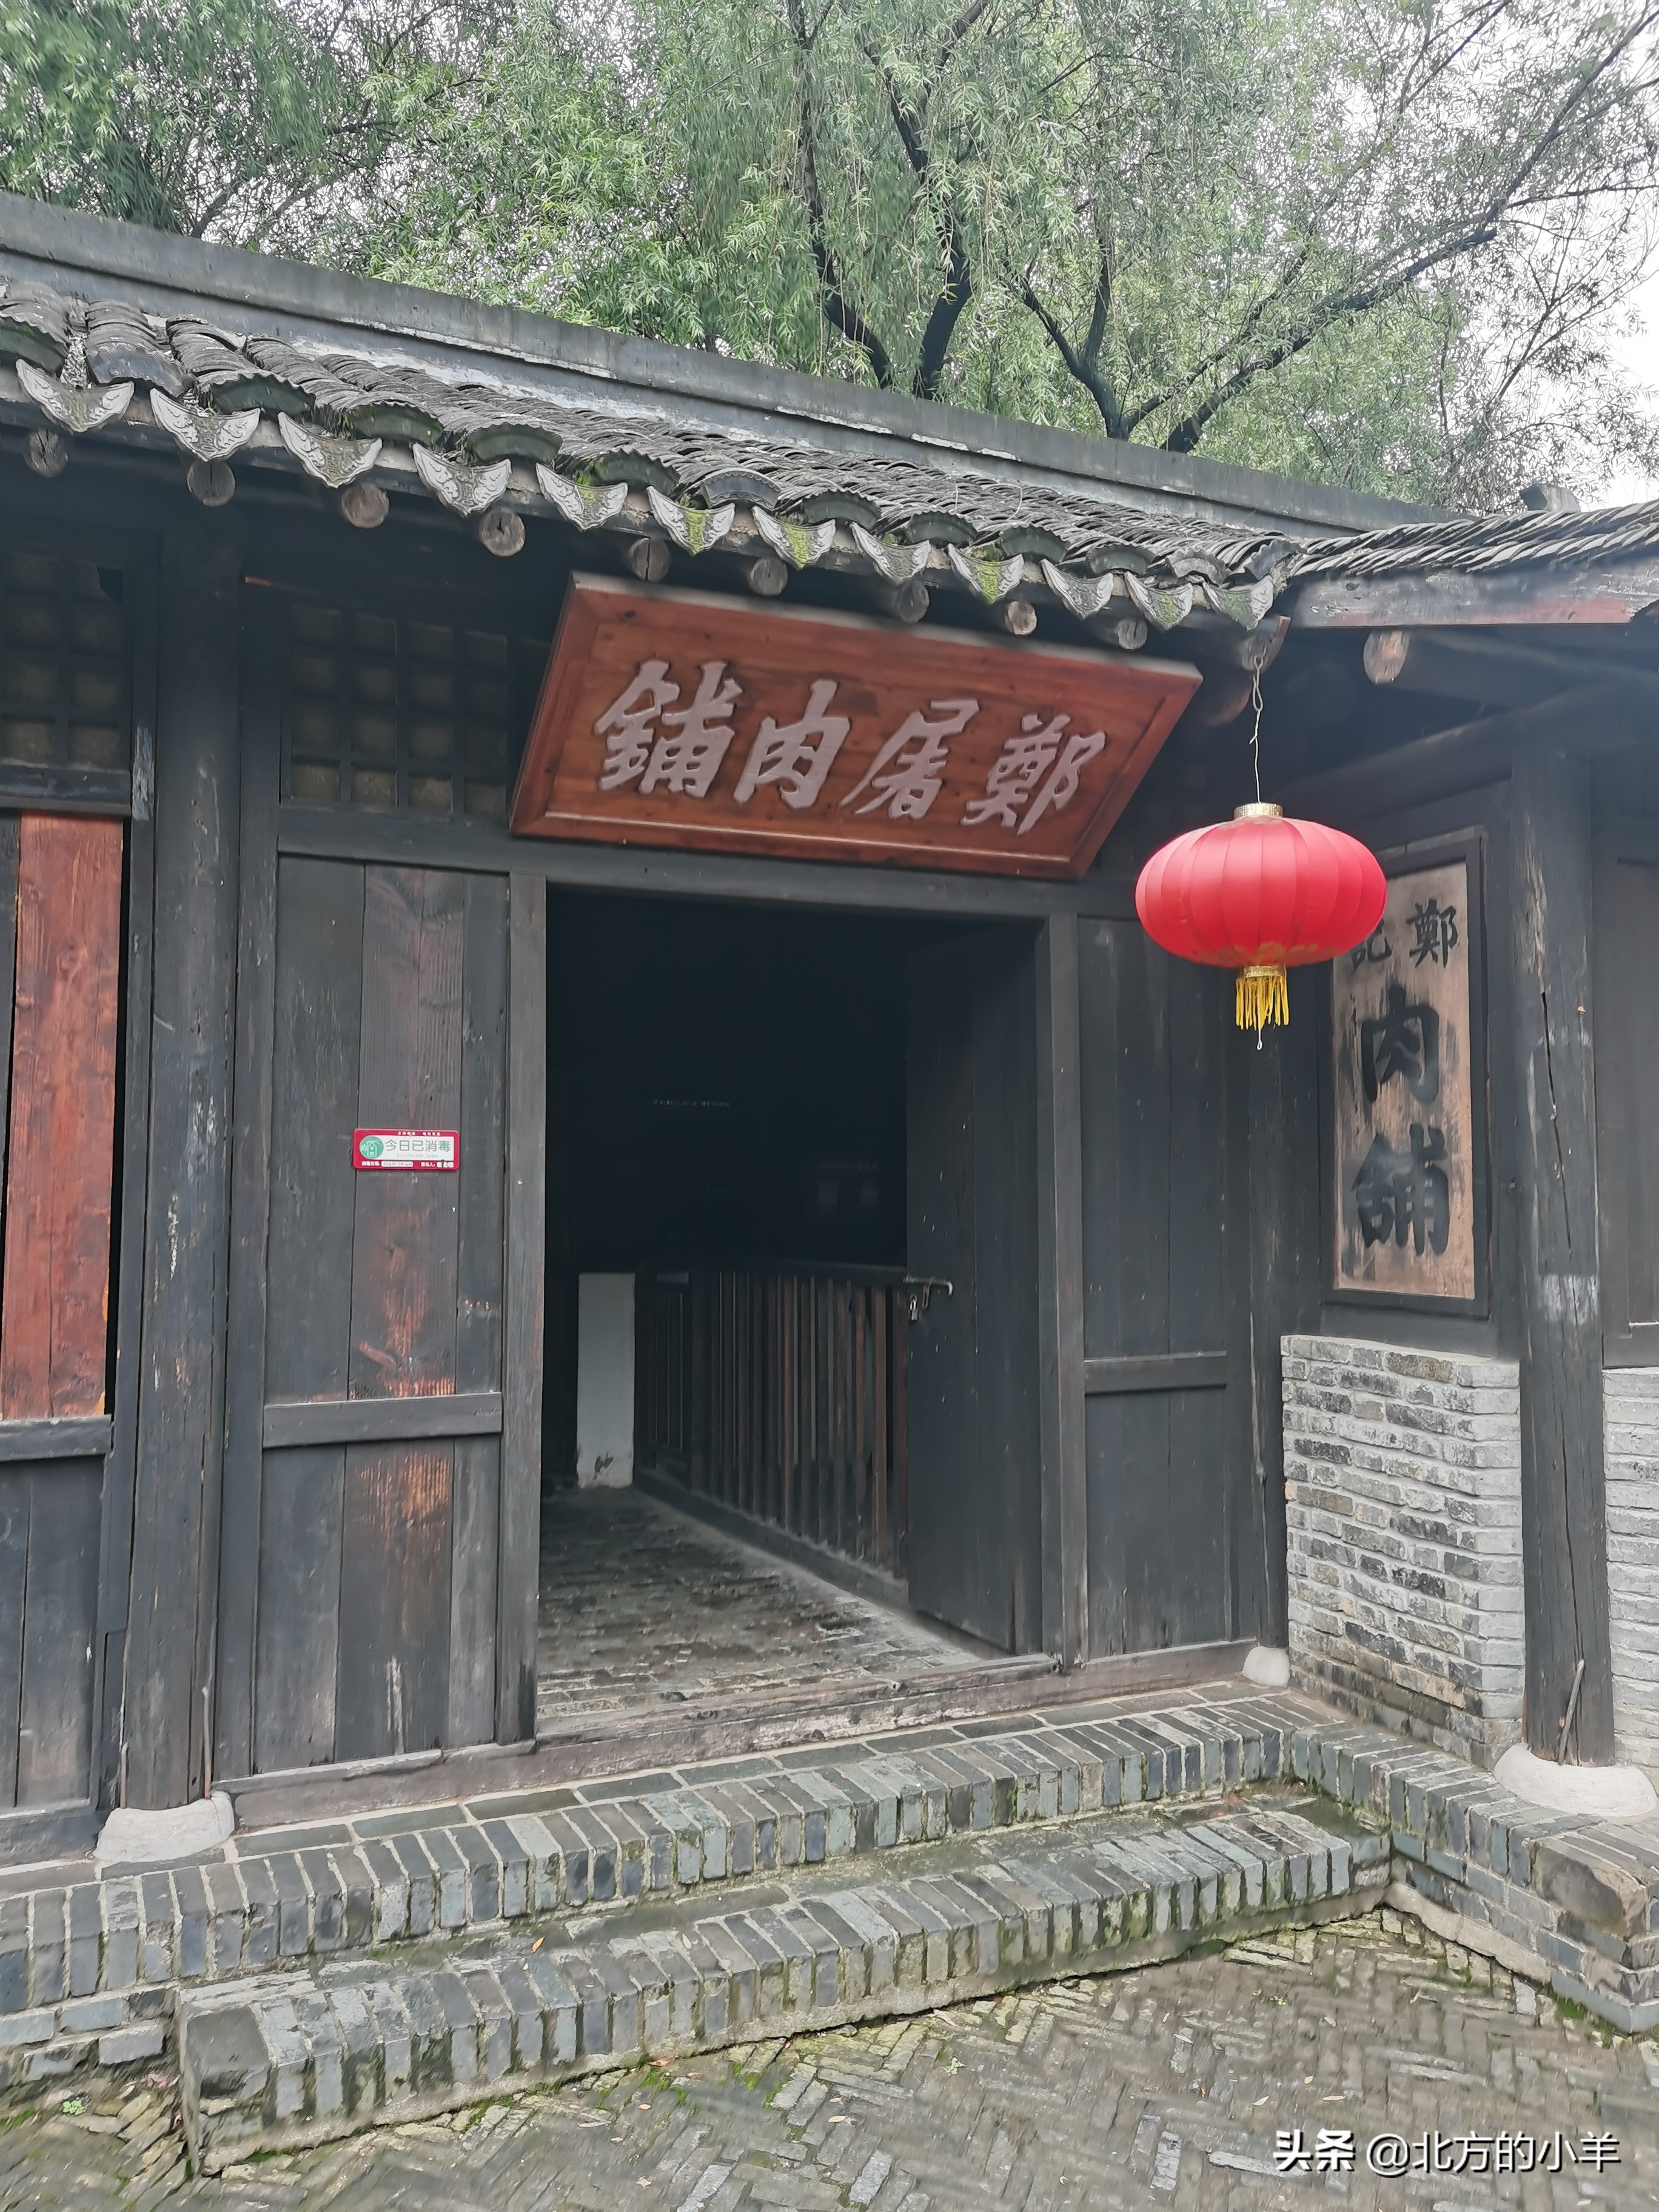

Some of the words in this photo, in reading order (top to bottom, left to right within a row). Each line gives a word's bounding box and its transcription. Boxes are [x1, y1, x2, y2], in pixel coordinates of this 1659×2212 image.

[384, 1139, 451, 1153] 今日已消毒
